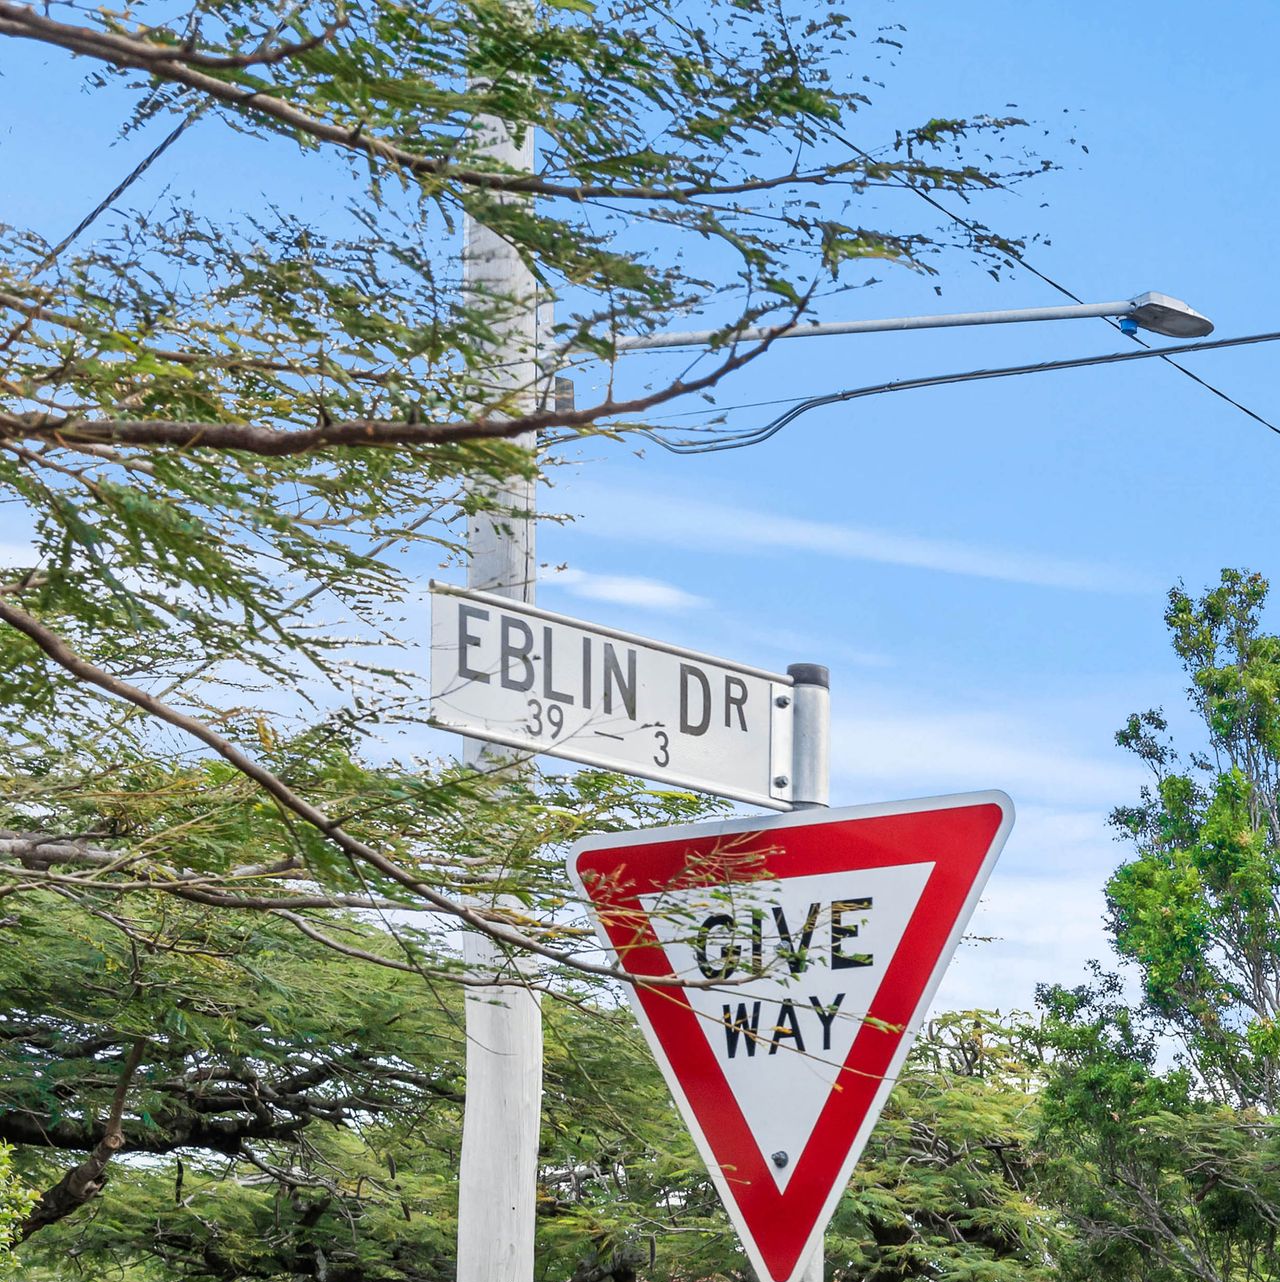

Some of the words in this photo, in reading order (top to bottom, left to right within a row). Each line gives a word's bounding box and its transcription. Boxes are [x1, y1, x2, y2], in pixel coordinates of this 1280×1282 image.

[458, 603, 637, 721] EBLIN
[680, 663, 748, 736] DR
[526, 699, 564, 740] 39
[653, 730, 670, 768] 3
[697, 897, 874, 980] GIVE
[722, 993, 846, 1059] WAY
